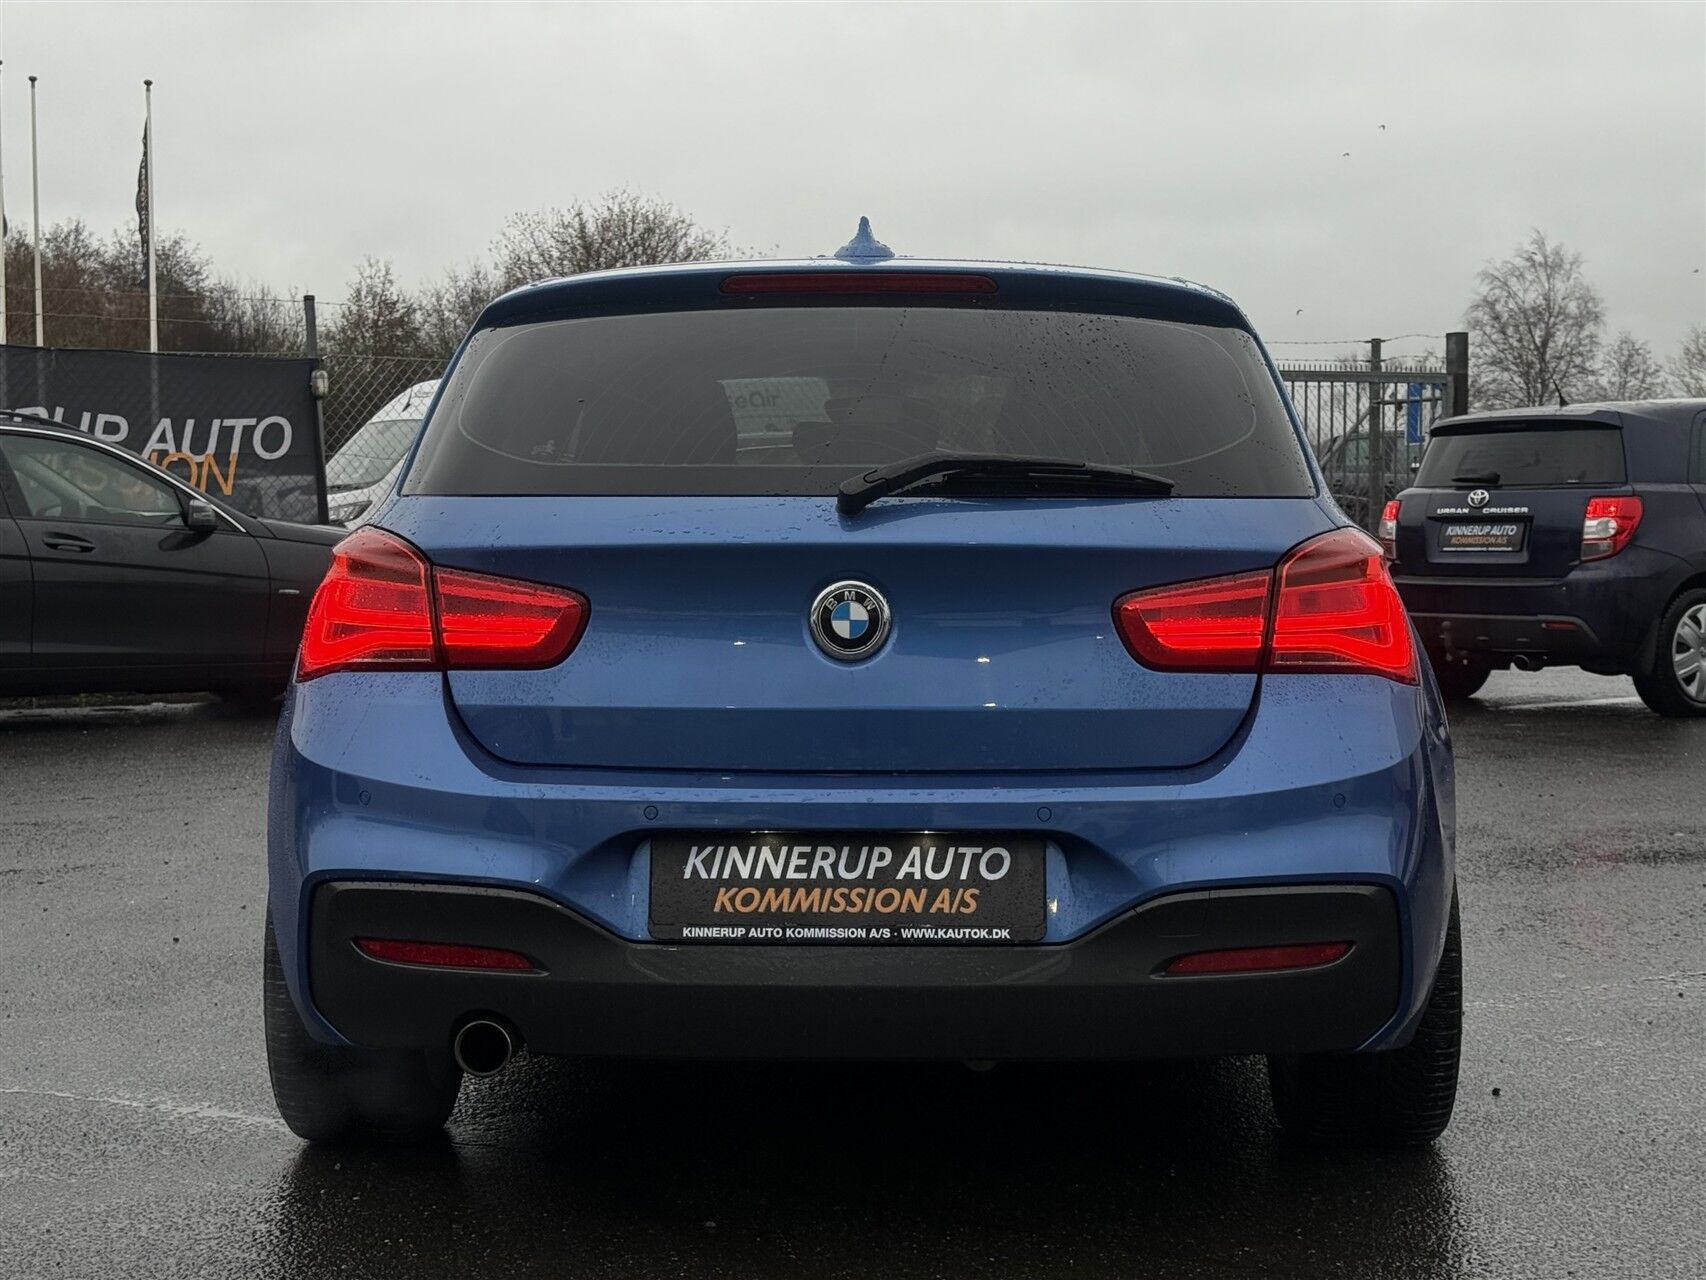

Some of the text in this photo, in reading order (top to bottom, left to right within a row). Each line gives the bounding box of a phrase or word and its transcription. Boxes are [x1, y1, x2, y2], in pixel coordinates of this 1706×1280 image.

[140, 415, 293, 462] AUTO
[1482, 506, 1529, 514] CRUISER
[1446, 525, 1517, 536] KINNERUP AUTO
[825, 590, 876, 611] BMW
[683, 845, 1011, 881] KINNERUP AUTO
[713, 887, 928, 913] KOMMISSION
[682, 927, 1011, 939] KINNERUP AUTO KOMMISSION A/S WWW.KAUTOK.DK
